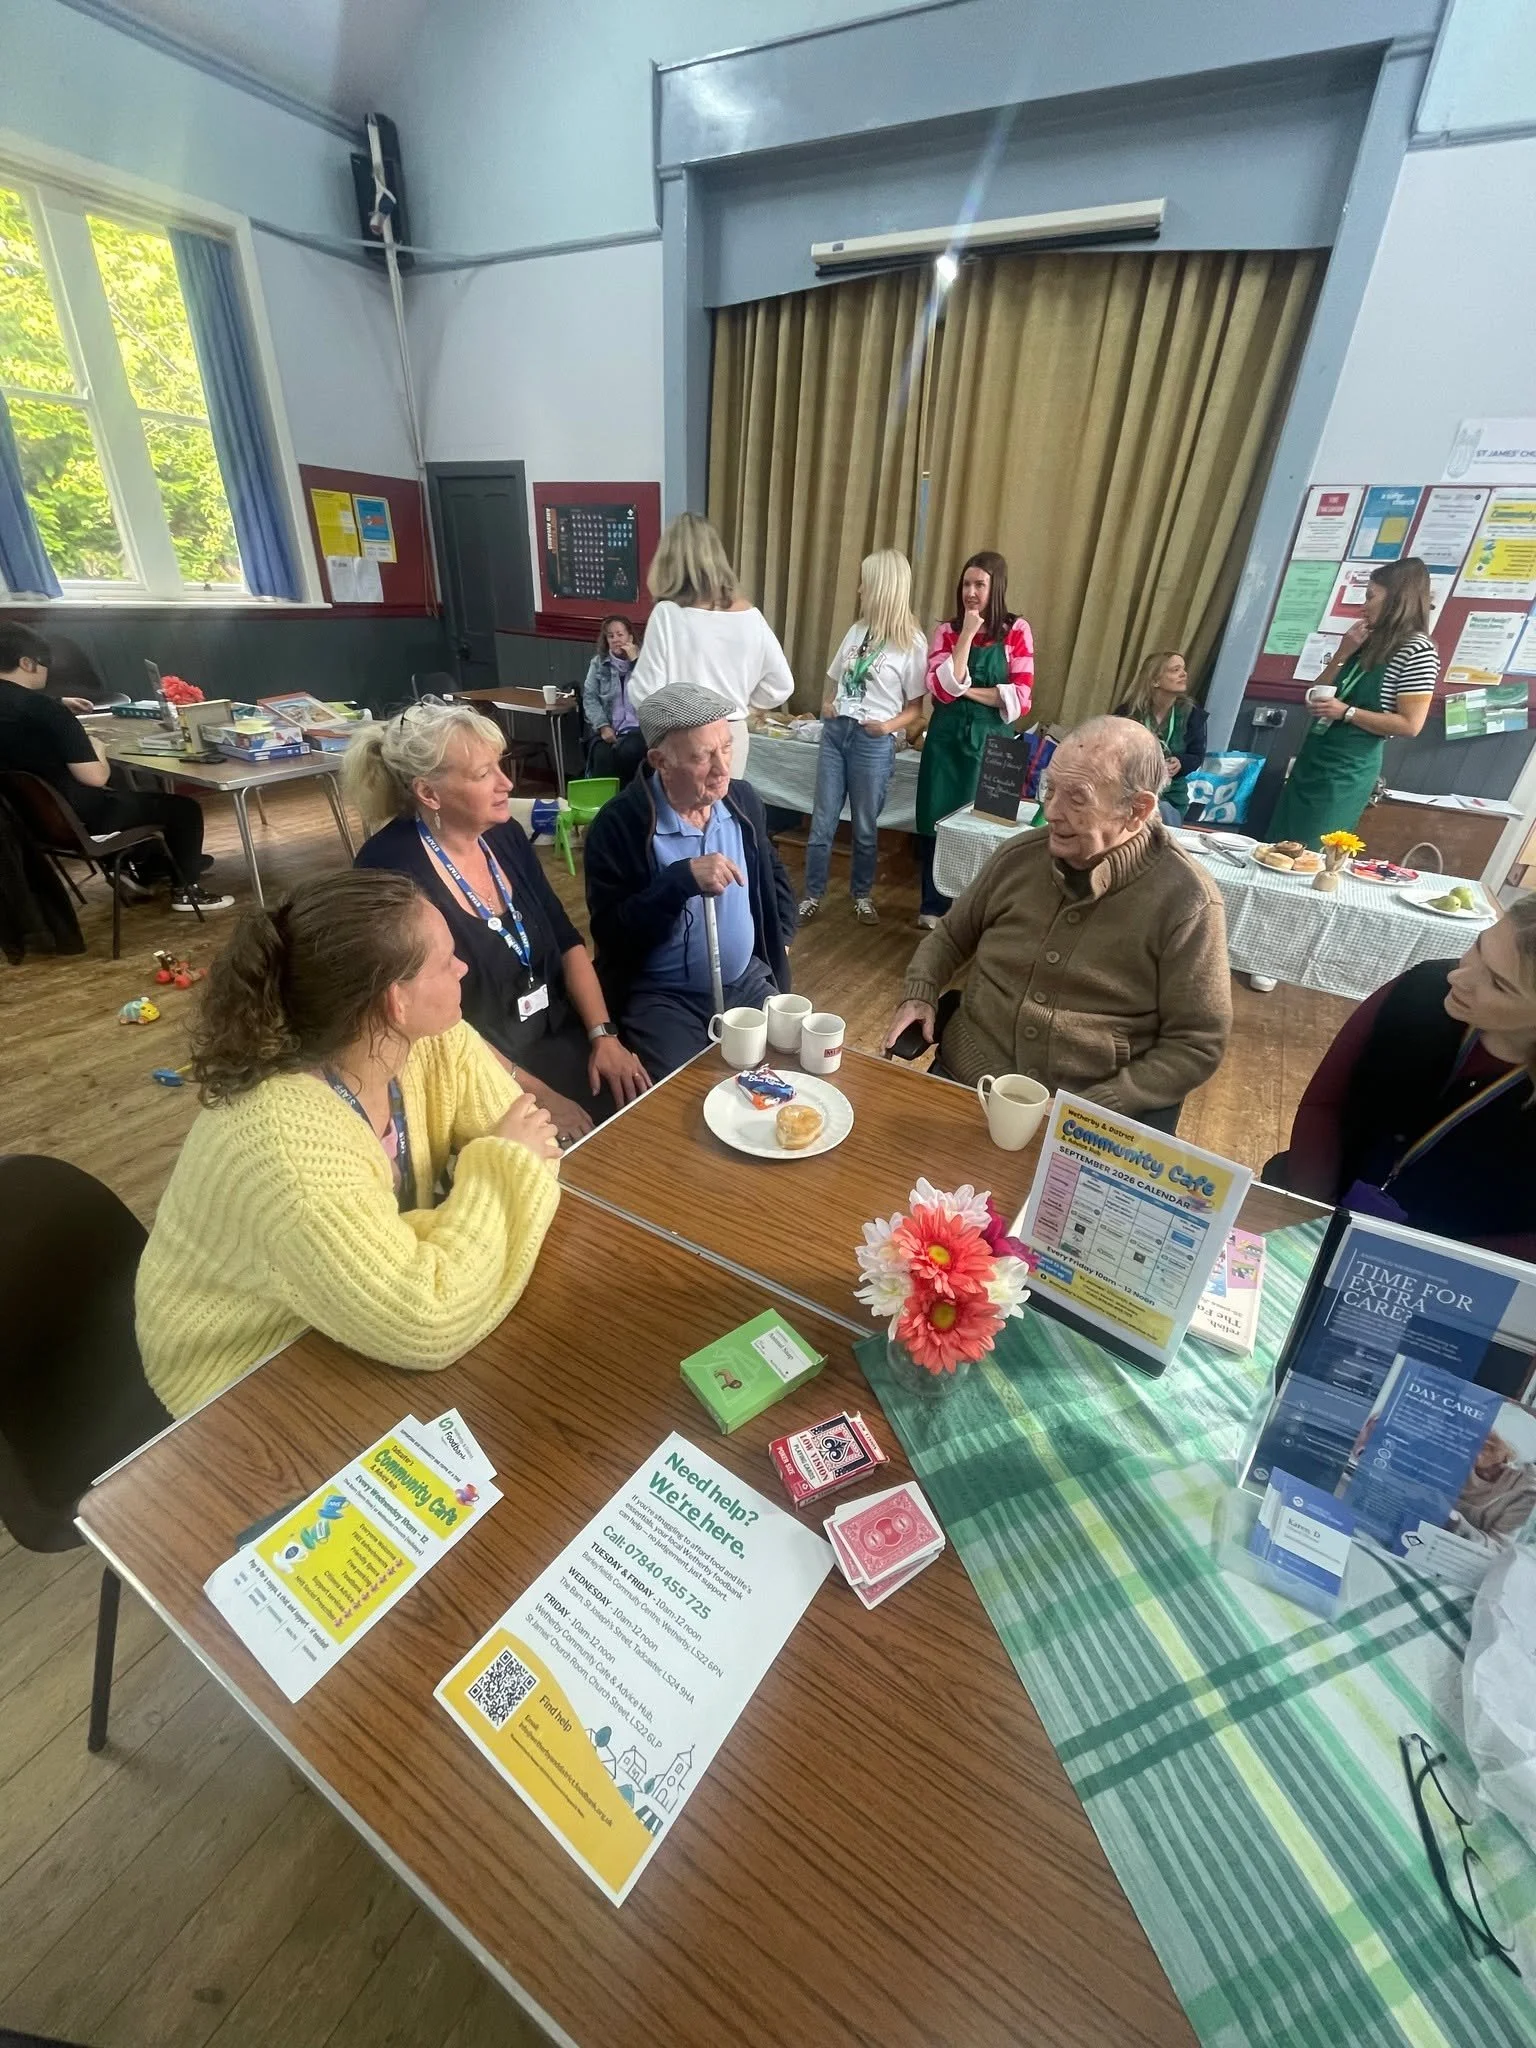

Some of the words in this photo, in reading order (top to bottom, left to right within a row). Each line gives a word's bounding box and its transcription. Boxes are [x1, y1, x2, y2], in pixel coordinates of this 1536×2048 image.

[1062, 1120, 1162, 1176] Community
[1168, 1165, 1214, 1196] Cafe
[1101, 1122, 1107, 1130] &
[1059, 1145, 1110, 1172] SEPTEMBER
[1112, 1169, 1134, 1184] 2026
[1136, 1181, 1190, 1208] CALENDAR
[1046, 1245, 1067, 1261] Every
[1068, 1257, 1093, 1274] Friday
[1095, 1270, 1116, 1285] 10am
[1124, 1285, 1131, 1293] 12
[1132, 1291, 1154, 1305] Noon
[1343, 1291, 1412, 1323] CARE?
[1348, 1275, 1426, 1312] EXTRA
[1353, 1261, 1416, 1292] TIME
[1421, 1283, 1472, 1311] FOR
[1408, 1383, 1439, 1400] DAY
[1442, 1398, 1484, 1420] CARE
[374, 1467, 390, 1482] Advice
[444, 1430, 466, 1461] Foodbank
[777, 1446, 788, 1463] POKER
[785, 1463, 795, 1474] SIZE
[793, 1444, 806, 1463] PLAYING
[803, 1463, 815, 1480] CARDS
[799, 1434, 813, 1450] LOW
[810, 1452, 828, 1481] VISION
[355, 1474, 372, 1491] Every
[370, 1488, 402, 1520] Wednesday
[400, 1517, 417, 1534] 10am
[419, 1534, 428, 1544] 12
[374, 1449, 431, 1506] Community
[428, 1497, 457, 1525] Cafe
[649, 1471, 700, 1520] We're
[699, 1512, 743, 1558] here.
[664, 1452, 712, 1492] Need
[708, 1484, 758, 1526] help?
[603, 1525, 625, 1548] Call:
[624, 1543, 662, 1577] 07840
[661, 1576, 687, 1598] 455
[685, 1593, 711, 1619] 725
[618, 1509, 630, 1520] can
[628, 1516, 642, 1530] help
[647, 1533, 656, 1542] no
[687, 1566, 702, 1579] just
[700, 1577, 726, 1601] support.
[635, 1499, 654, 1515] you're
[653, 1513, 683, 1540] struggling
[683, 1536, 691, 1544] to
[689, 1543, 710, 1560] afford
[709, 1557, 725, 1572] food
[723, 1569, 737, 1582] and
[735, 1577, 752, 1594] life's
[653, 1525, 668, 1538] your
[667, 1535, 683, 1551] local
[682, 1547, 712, 1575] Wetherby
[712, 1572, 742, 1599] foodbank
[568, 1566, 611, 1606] WEDNESDAY
[612, 1607, 642, 1636] 10am-12
[639, 1633, 658, 1651] noon
[581, 1550, 613, 1581] Barleyfields
[690, 1646, 708, 1665] LS22
[707, 1661, 723, 1677] 6PN
[591, 1541, 622, 1570] TUESDAY
[620, 1568, 628, 1577] &
[626, 1573, 654, 1597] FRIDAY
[655, 1598, 685, 1626] 10am-12
[682, 1623, 701, 1641] noon
[535, 1602, 563, 1633] Wetherby
[561, 1629, 596, 1665] Community
[595, 1661, 610, 1679] Cafe
[609, 1675, 617, 1685] &
[615, 1682, 638, 1707] Advice
[543, 1592, 570, 1617] FRIDAY
[570, 1618, 600, 1647] 10am-12
[597, 1645, 615, 1663] noon
[559, 1575, 570, 1589] The
[583, 1599, 591, 1608] St
[589, 1605, 614, 1629] Joseph's
[661, 1670, 680, 1690] LS24
[678, 1686, 694, 1704] 9HA
[525, 1613, 533, 1623] St
[550, 1637, 570, 1660] Church
[588, 1675, 610, 1700] Church
[629, 1715, 648, 1737] LS22
[646, 1732, 662, 1748] 6LP
[539, 1694, 558, 1715] Find
[554, 1710, 571, 1731] help
